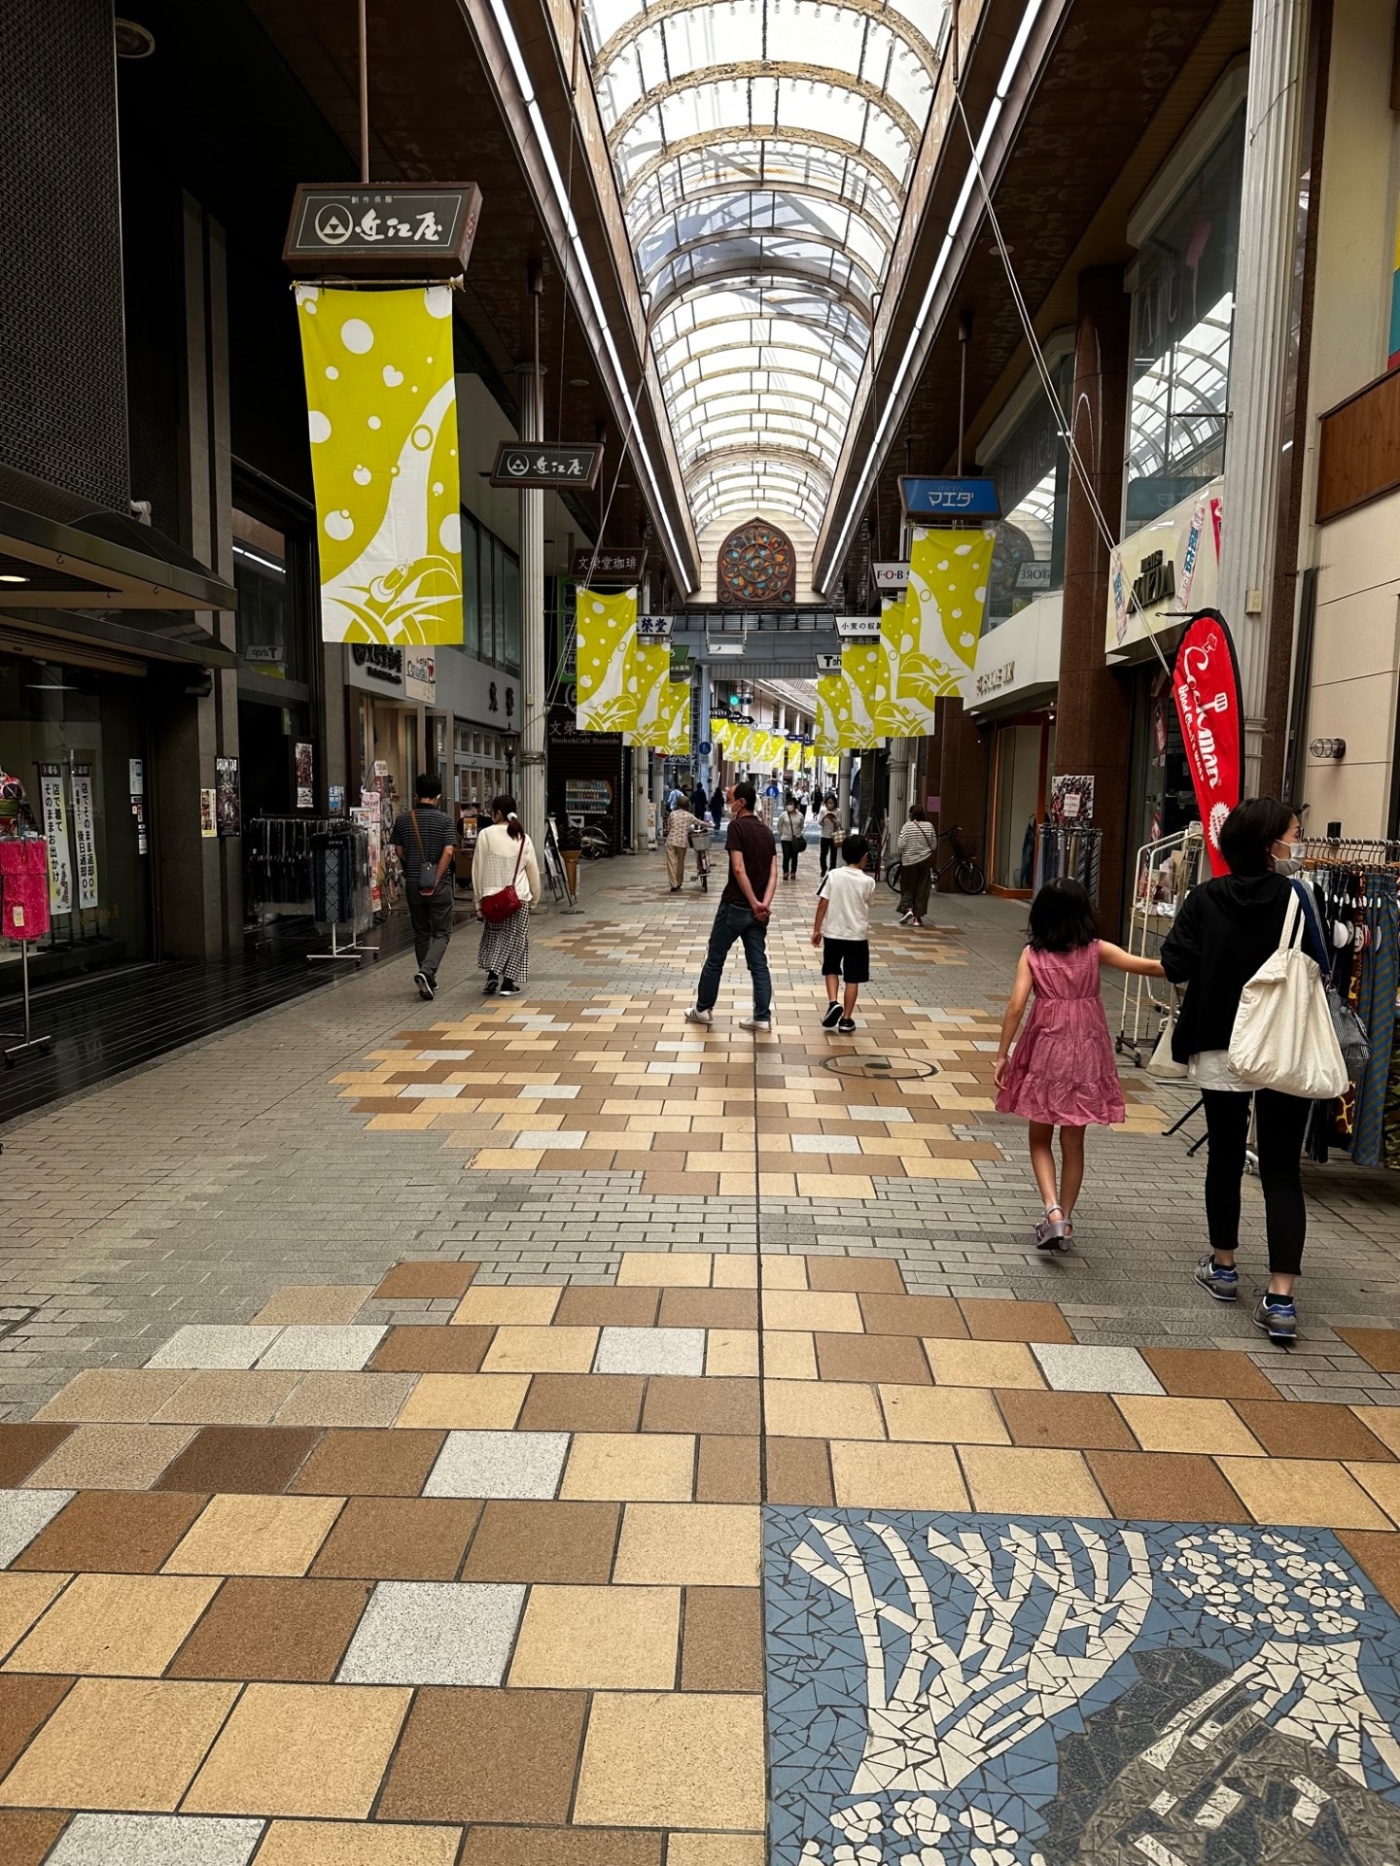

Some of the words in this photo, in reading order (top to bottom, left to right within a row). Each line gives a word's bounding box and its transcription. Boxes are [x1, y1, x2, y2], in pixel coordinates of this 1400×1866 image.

[354, 207, 443, 242] 近江屋
[532, 455, 584, 476] 近江屋
[927, 491, 975, 507] マエダ
[53, 783, 62, 832] 店で着て
